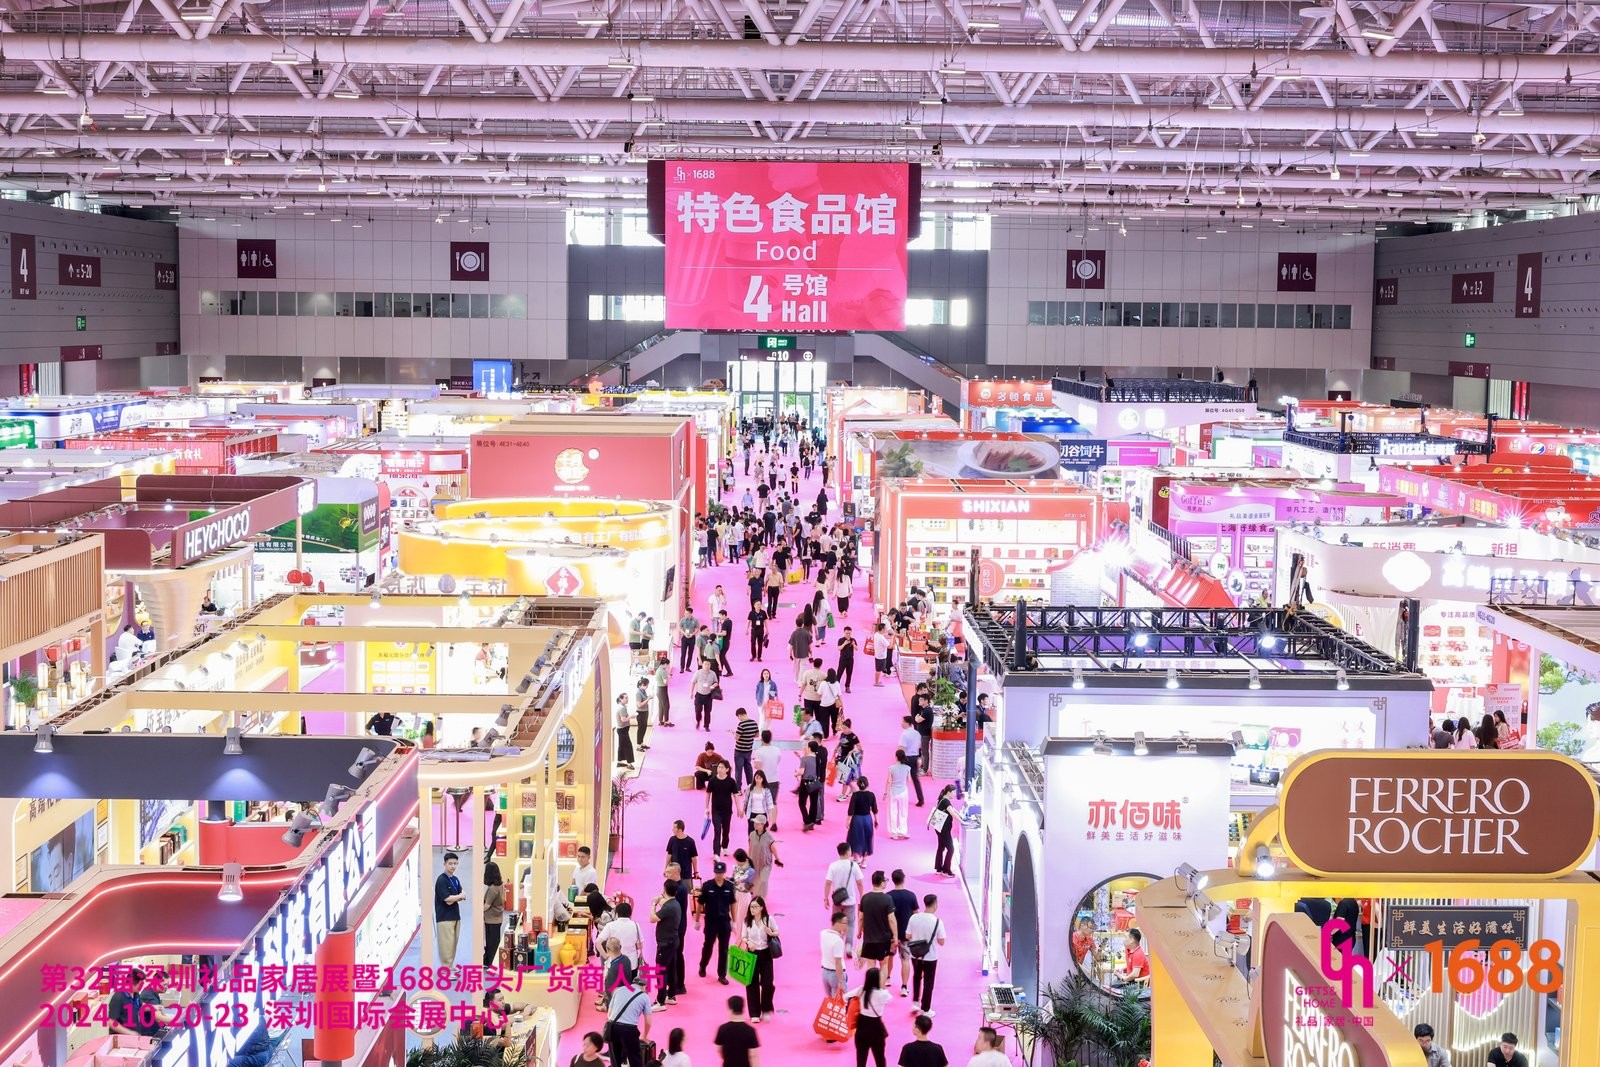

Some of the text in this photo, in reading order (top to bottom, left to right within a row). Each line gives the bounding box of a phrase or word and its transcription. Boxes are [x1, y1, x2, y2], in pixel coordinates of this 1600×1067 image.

[693, 170, 715, 179] 1688
[677, 191, 897, 235] 特色食品馆
[756, 240, 817, 261] Food
[20, 248, 28, 282] 4
[81, 264, 92, 279] 5-20
[1474, 281, 1483, 295] 1-2
[1524, 267, 1532, 301] 4
[743, 274, 828, 322] 4 号馆
[782, 300, 827, 323] Hall
[777, 351, 789, 361] 10
[962, 499, 1031, 514] SHIXIAN
[185, 509, 250, 560] HEYCHOCO
[1349, 777, 1531, 815] FERRERO
[1088, 799, 1182, 830] 亦佰味
[1086, 831, 1182, 841] 鲜美生活好滋味
[1347, 817, 1529, 856] ROCHER
[1402, 920, 1516, 936] 鲜美生活好滋味
